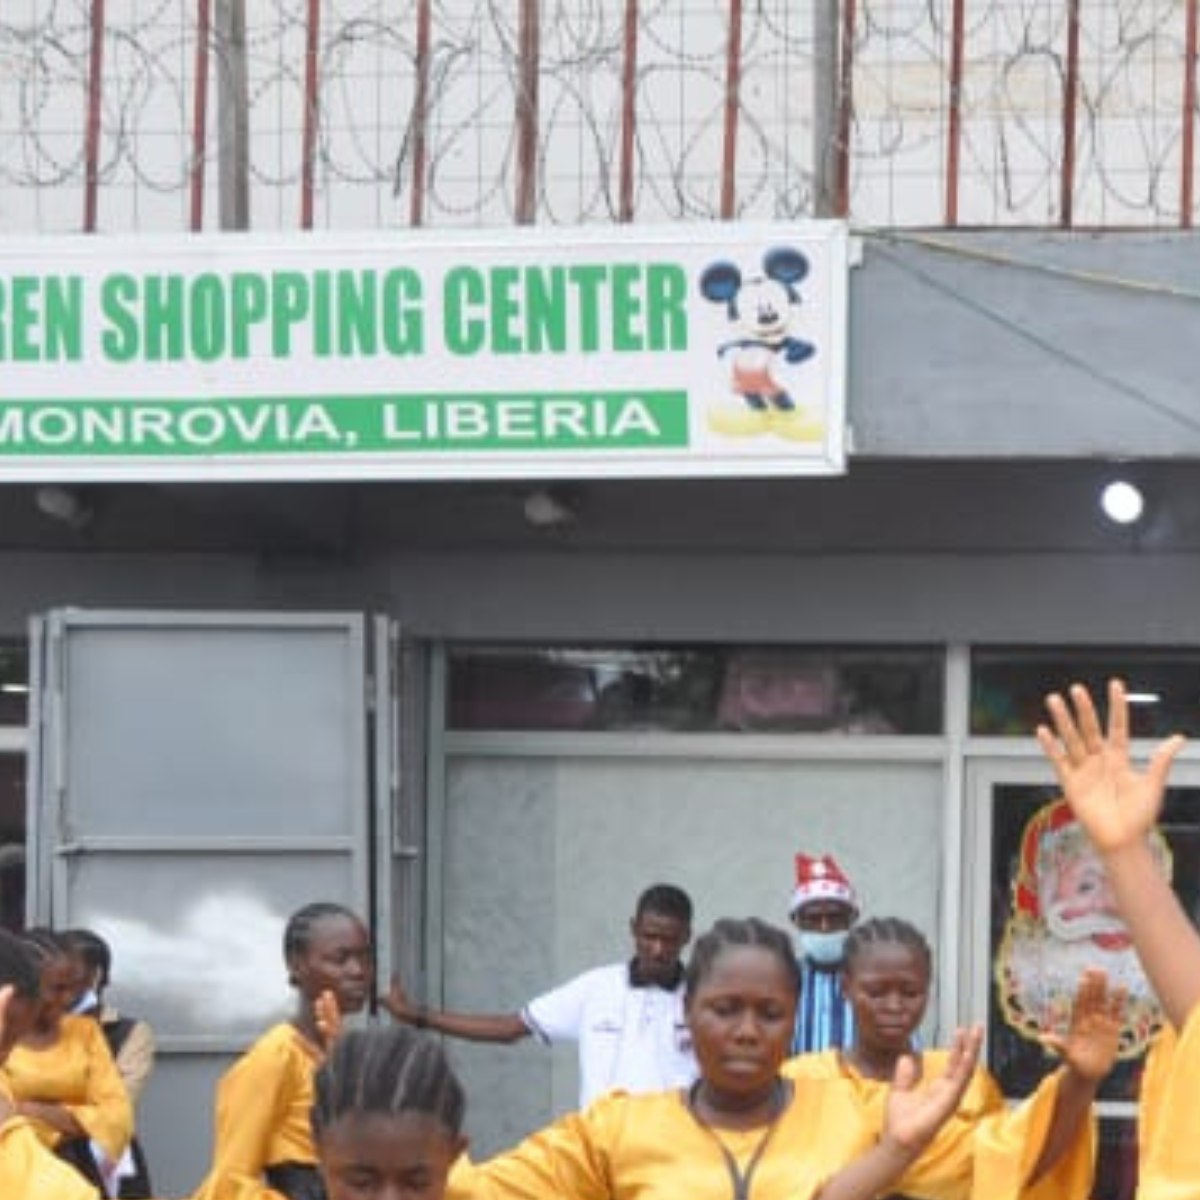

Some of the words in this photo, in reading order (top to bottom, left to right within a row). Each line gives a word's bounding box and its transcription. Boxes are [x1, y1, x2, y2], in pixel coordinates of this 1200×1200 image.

[0, 277, 82, 361] EN
[102, 269, 424, 361] SHOPPING
[444, 264, 688, 355] CENTER
[384, 398, 660, 440] LIBERIA
